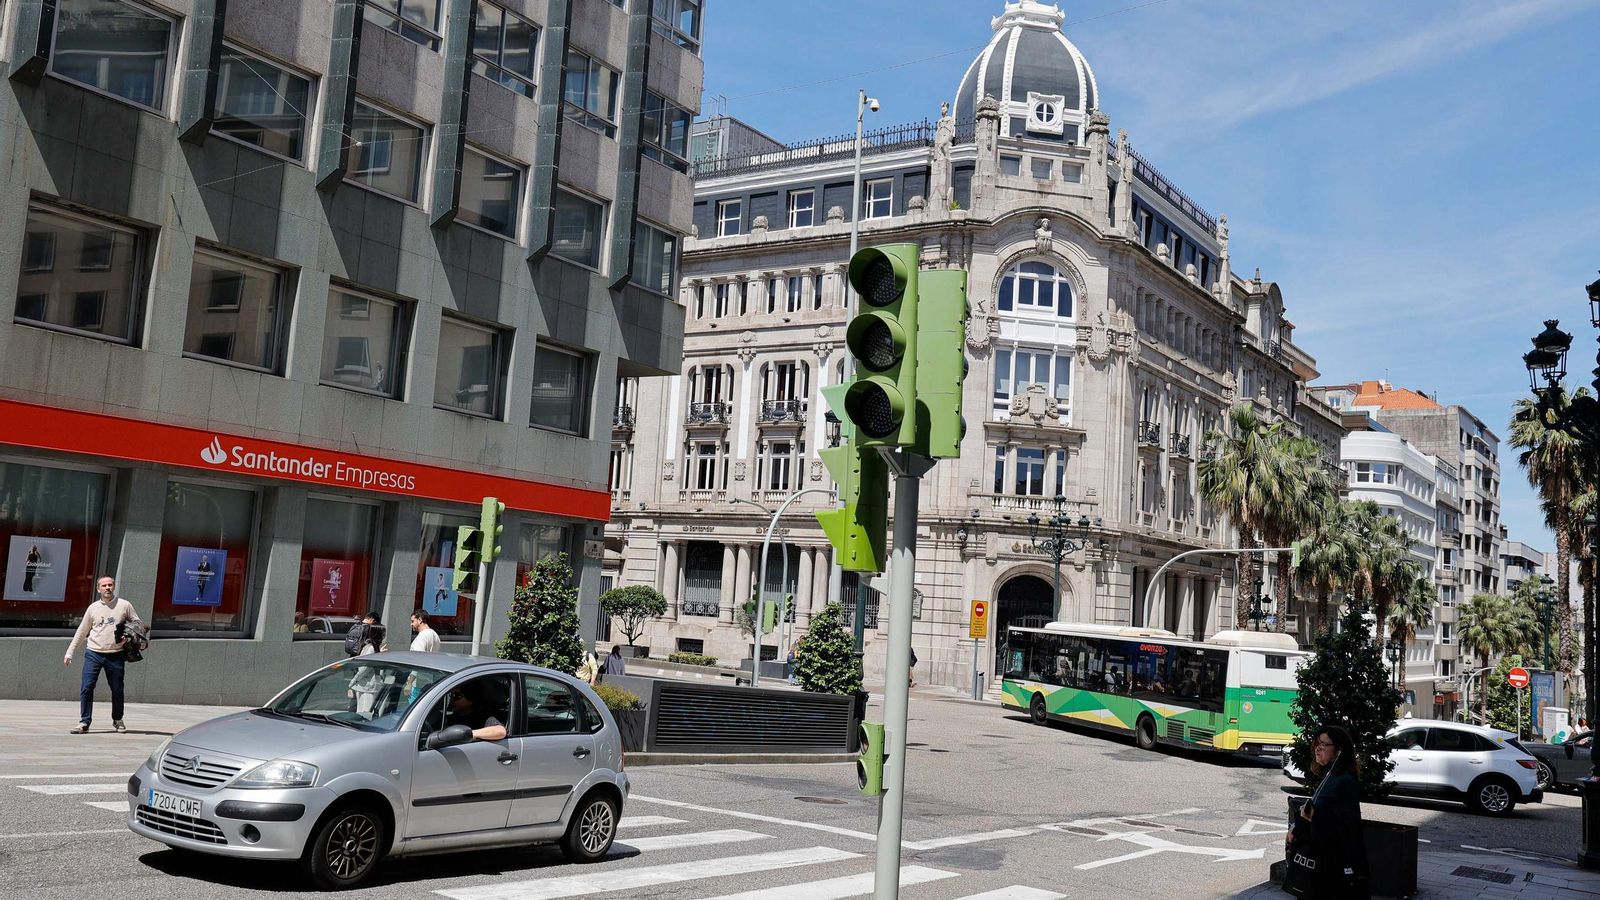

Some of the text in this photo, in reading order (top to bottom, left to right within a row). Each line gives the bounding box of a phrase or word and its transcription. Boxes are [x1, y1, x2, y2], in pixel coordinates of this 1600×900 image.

[231, 446, 415, 491] Santander Empresas
[154, 793, 177, 811] 7204
